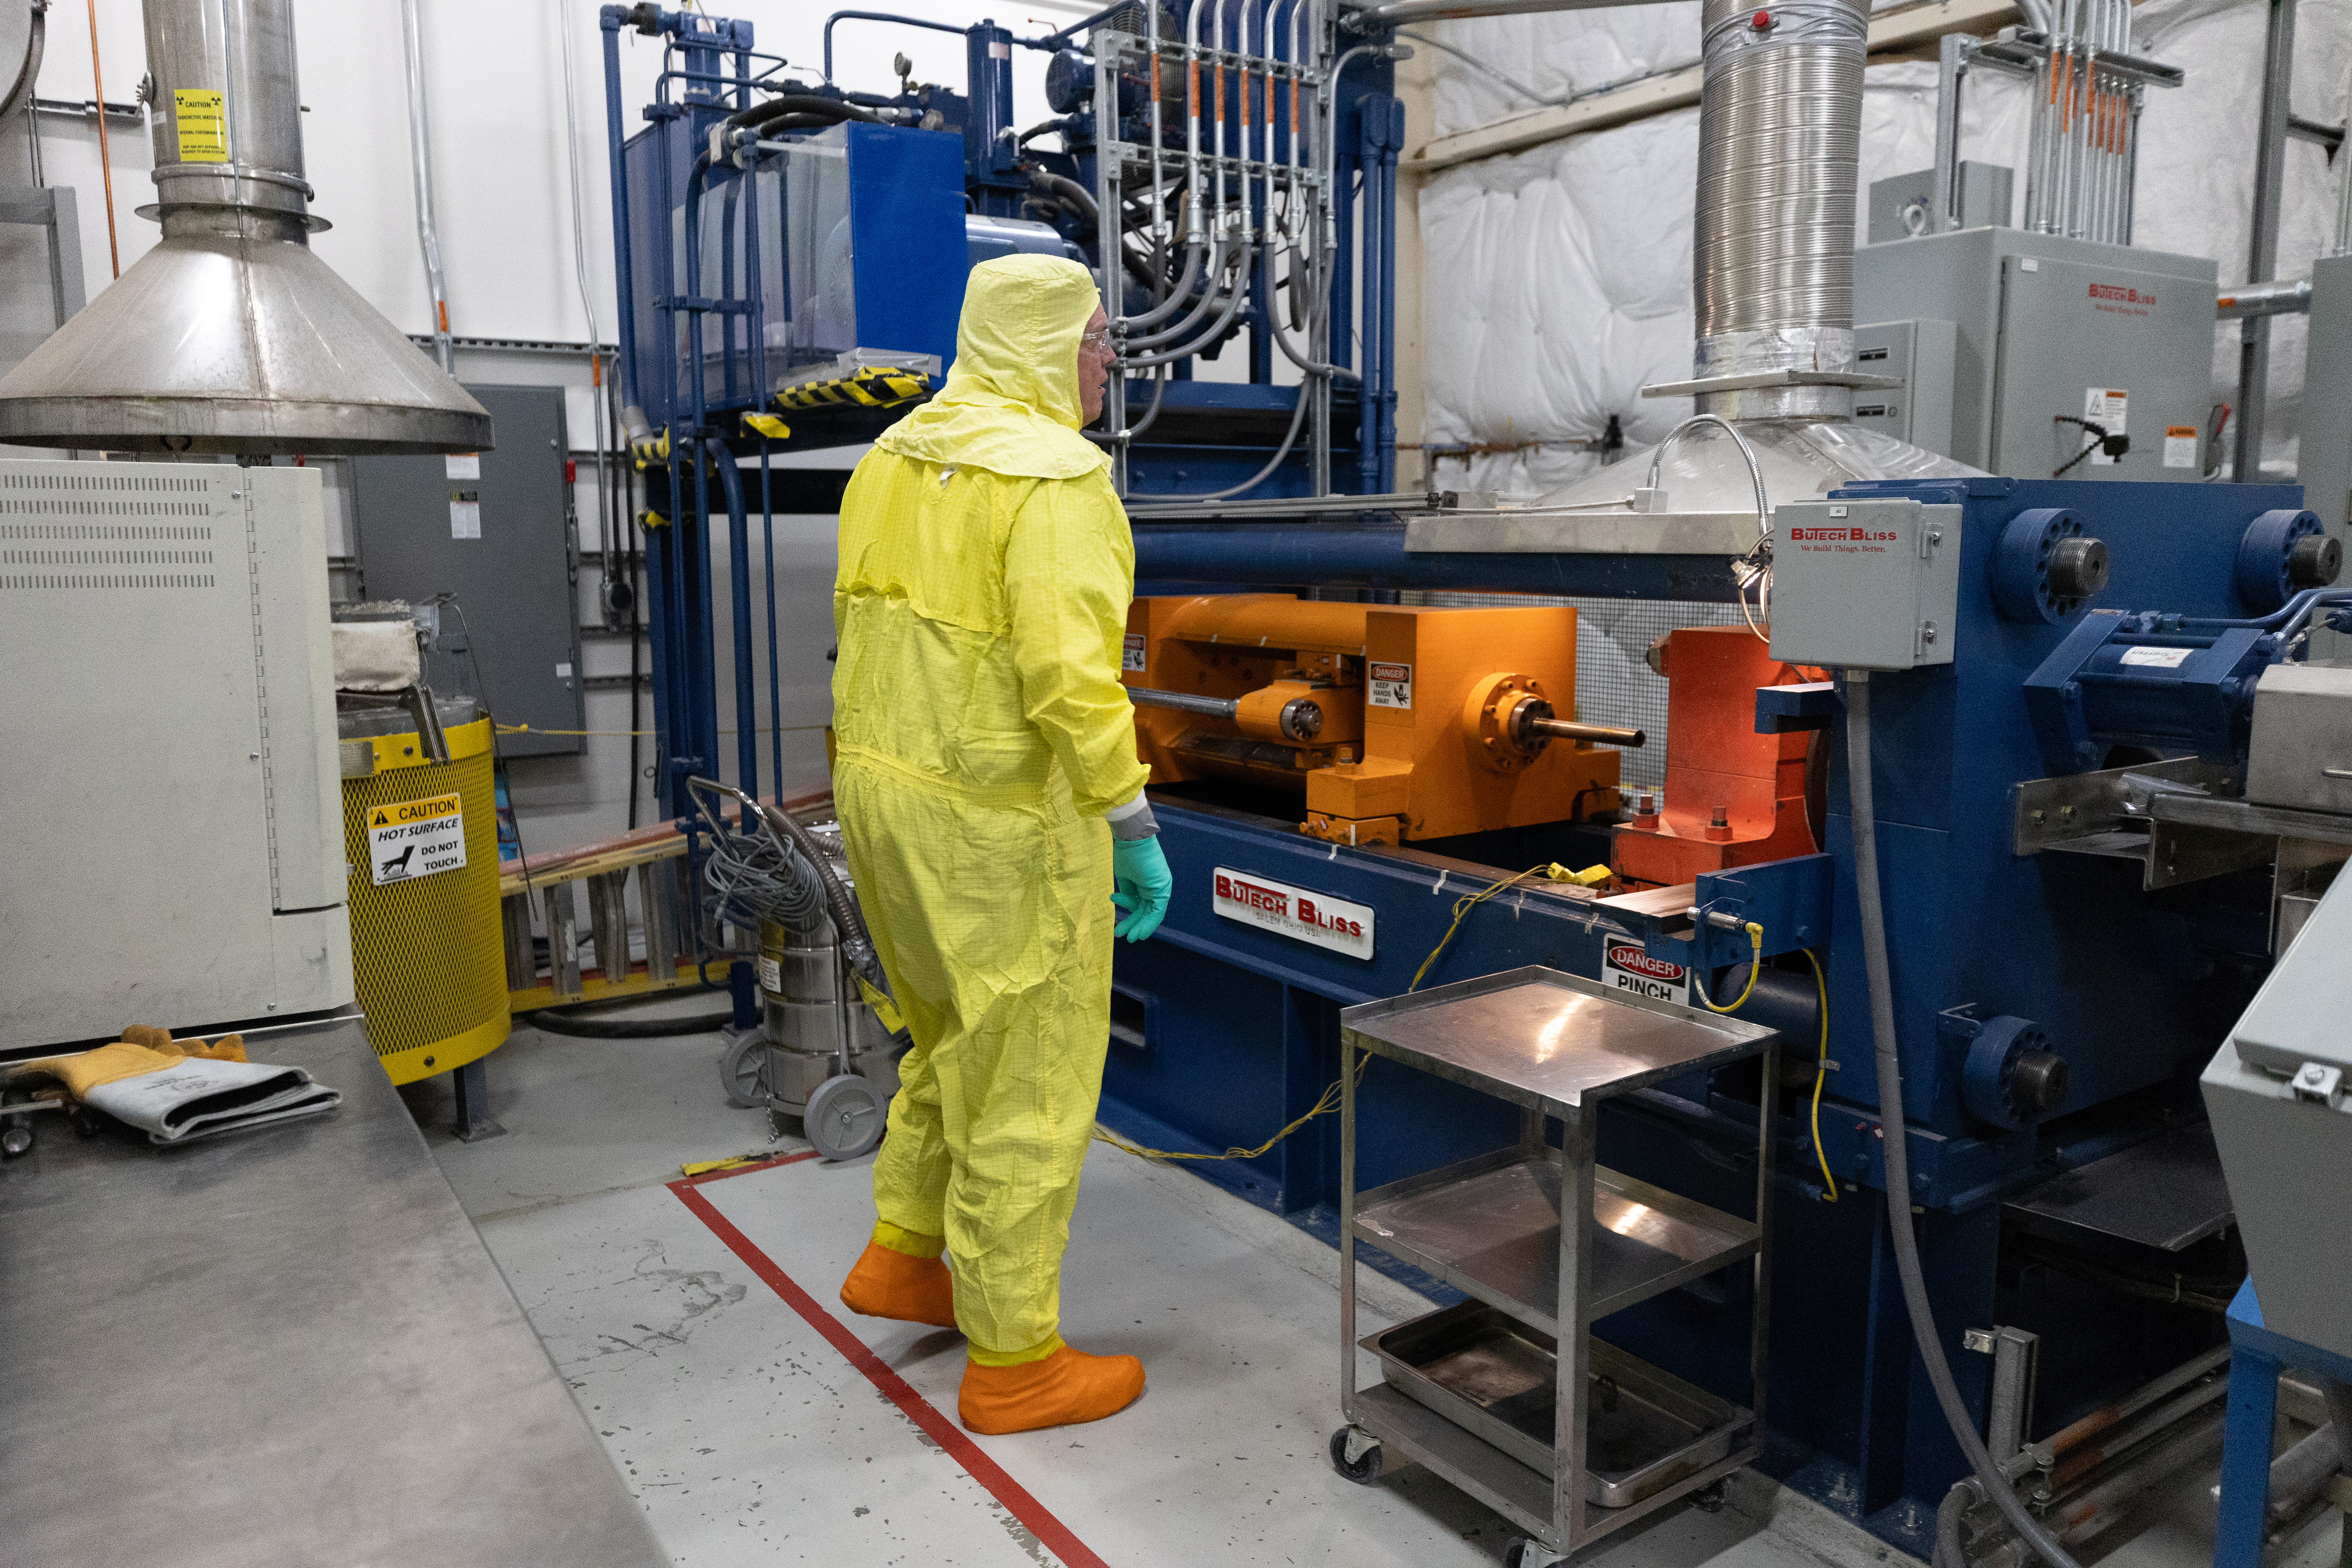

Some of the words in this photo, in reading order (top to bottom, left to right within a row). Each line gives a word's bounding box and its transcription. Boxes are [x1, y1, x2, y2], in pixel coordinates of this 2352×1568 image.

[1791, 528, 1847, 540] BUTECH
[1850, 528, 1897, 541] BLISS
[1834, 545, 1859, 553] Things.
[1376, 668, 1404, 679] DANGER
[399, 799, 455, 820] CAUTION
[378, 827, 406, 842] HOT
[408, 818, 459, 837] SURFACE
[421, 845, 436, 855] DO
[438, 841, 459, 852] NOT
[424, 857, 458, 871] TOUCH
[1216, 874, 1288, 916] BUTECH
[1298, 897, 1362, 937] BLISS
[1256, 912, 1281, 927] SALEM
[1283, 919, 1303, 933] OHIO
[1305, 925, 1321, 938] USA
[1617, 949, 1675, 977] DANGER
[1618, 974, 1672, 1001] PINCH
